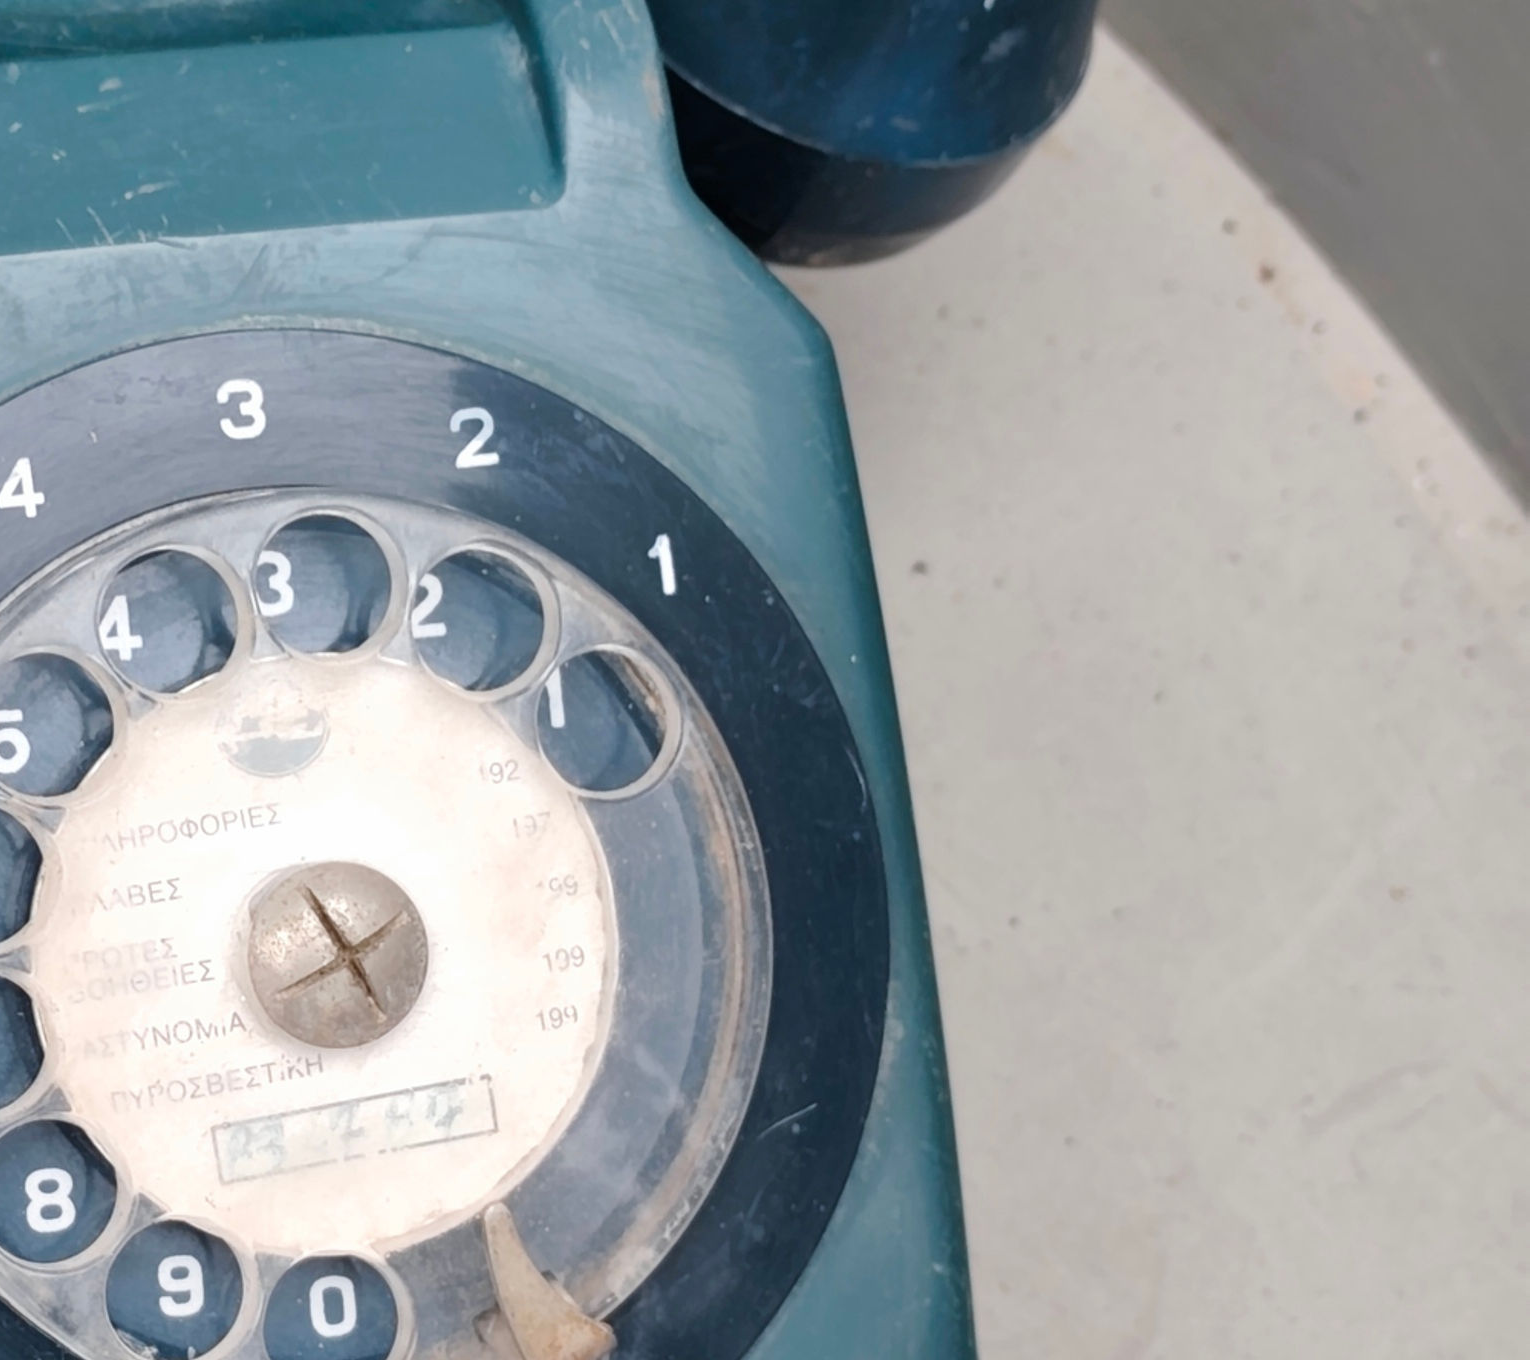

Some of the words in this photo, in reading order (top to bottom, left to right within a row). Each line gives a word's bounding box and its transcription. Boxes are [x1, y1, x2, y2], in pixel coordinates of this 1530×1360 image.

[215, 377, 267, 440] 3
[449, 407, 500, 469] 2
[256, 549, 296, 618] 3
[646, 534, 677, 596] 1
[97, 594, 144, 662] 4
[410, 572, 448, 640] 2
[94, 801, 283, 853] ΛΗΡΟΦΟΡΙΕΣ
[82, 876, 183, 913] ΛΑΒΕΣ
[72, 937, 179, 972] ΡΩΤΕΣ
[24, 1167, 76, 1233] 8
[157, 1255, 204, 1317] 9
[309, 1275, 357, 1338] 0
